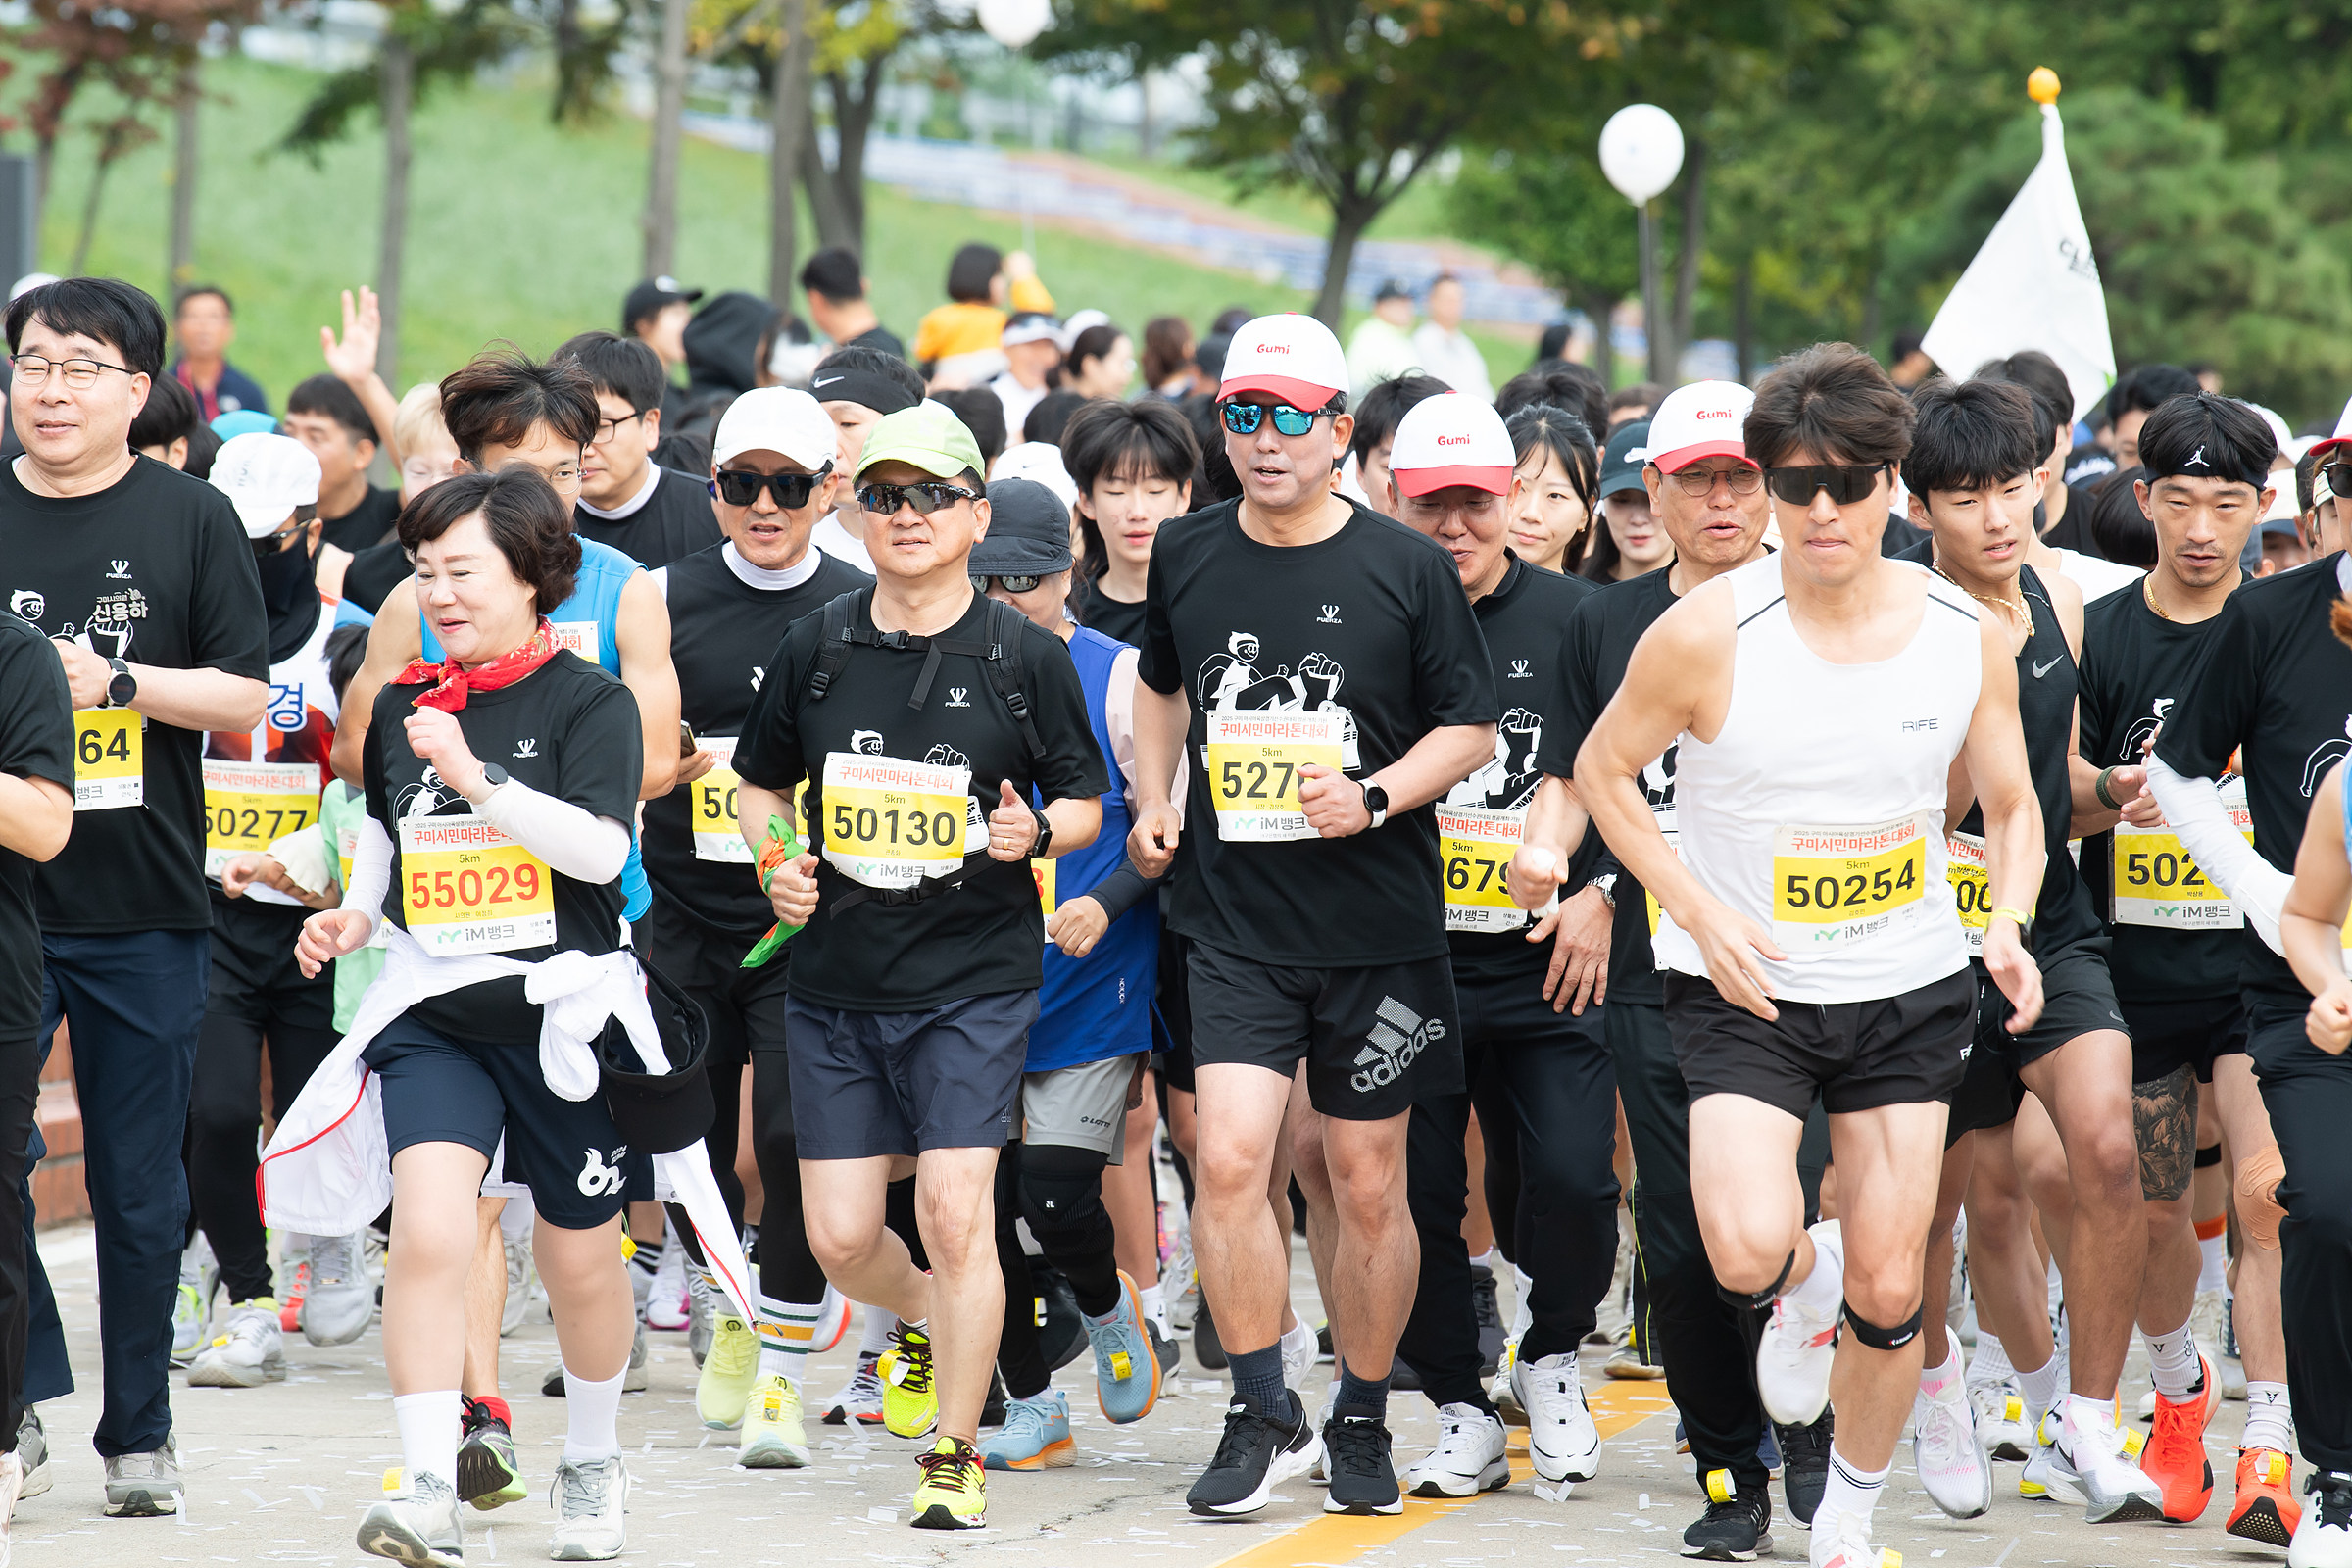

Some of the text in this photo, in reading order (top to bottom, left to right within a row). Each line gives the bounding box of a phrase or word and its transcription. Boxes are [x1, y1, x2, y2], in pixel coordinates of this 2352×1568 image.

[1257, 344, 1290, 354] Gumi
[1697, 409, 1732, 419] Gumi
[1438, 434, 1470, 445] Gumi
[92, 601, 149, 623] 신용하
[1220, 723, 1329, 739] 구미시민마라톤대회
[1902, 718, 1938, 732] RIFE
[1262, 748, 1283, 757] 5km
[839, 766, 954, 790] 구미시민마라톤대회
[884, 794, 906, 804] 5km
[834, 805, 956, 846] 50130
[414, 826, 514, 845] 구미시민마라톤
[1791, 823, 1915, 852] 구미시민마라톤대회
[1452, 842, 1473, 853] 5km
[459, 855, 480, 863] 5km
[1846, 860, 1870, 870] 5km
[412, 863, 540, 909] 55029
[1787, 858, 1916, 909] 50254
[1350, 1018, 1446, 1093] adidas
